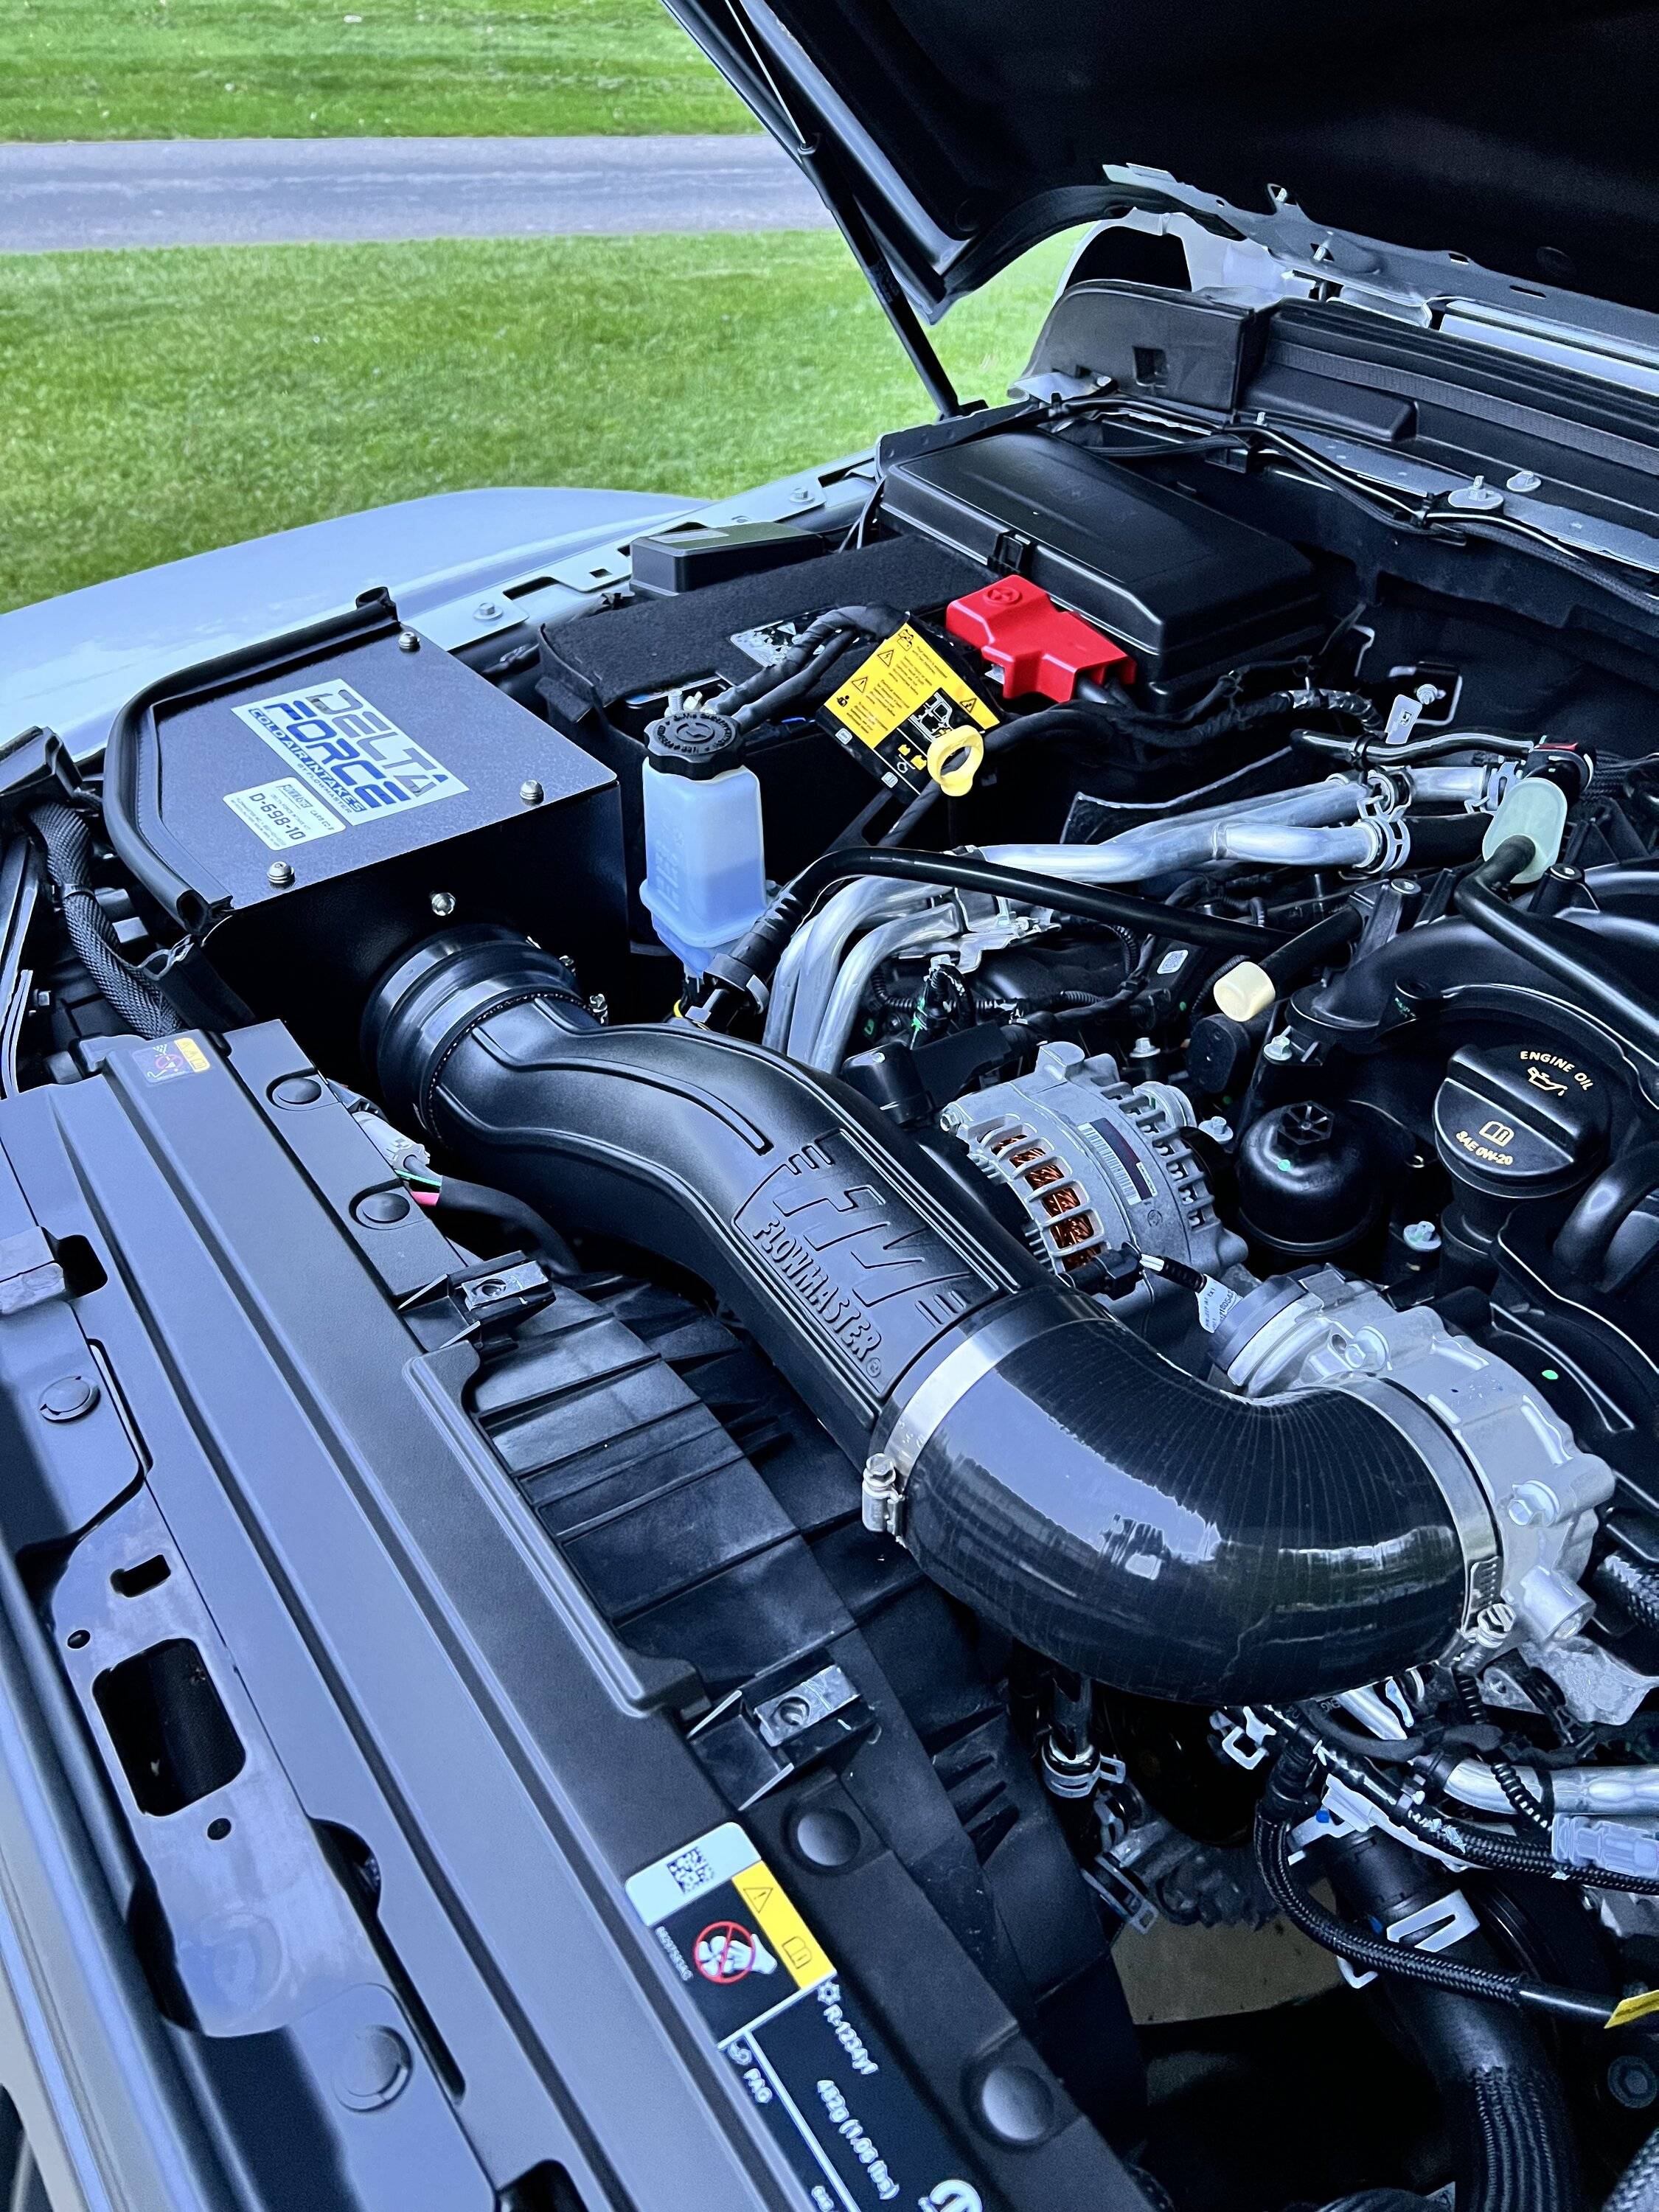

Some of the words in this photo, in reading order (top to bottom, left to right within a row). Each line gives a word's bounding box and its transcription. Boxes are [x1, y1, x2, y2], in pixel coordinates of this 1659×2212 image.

[249, 709, 286, 738] COLD
[281, 740, 308, 759] AIR
[305, 760, 365, 812] INTAKES
[262, 700, 411, 808] FORCE
[305, 689, 448, 797] DELTA
[248, 793, 306, 841] D-698-10
[307, 772, 352, 813] FLOWMASTER
[1520, 1051, 1575, 1072] ENGINE
[1574, 1072, 1593, 1091] OIL
[1455, 1130, 1479, 1152] SAE
[751, 1217, 882, 1363] FLOWMASTER
